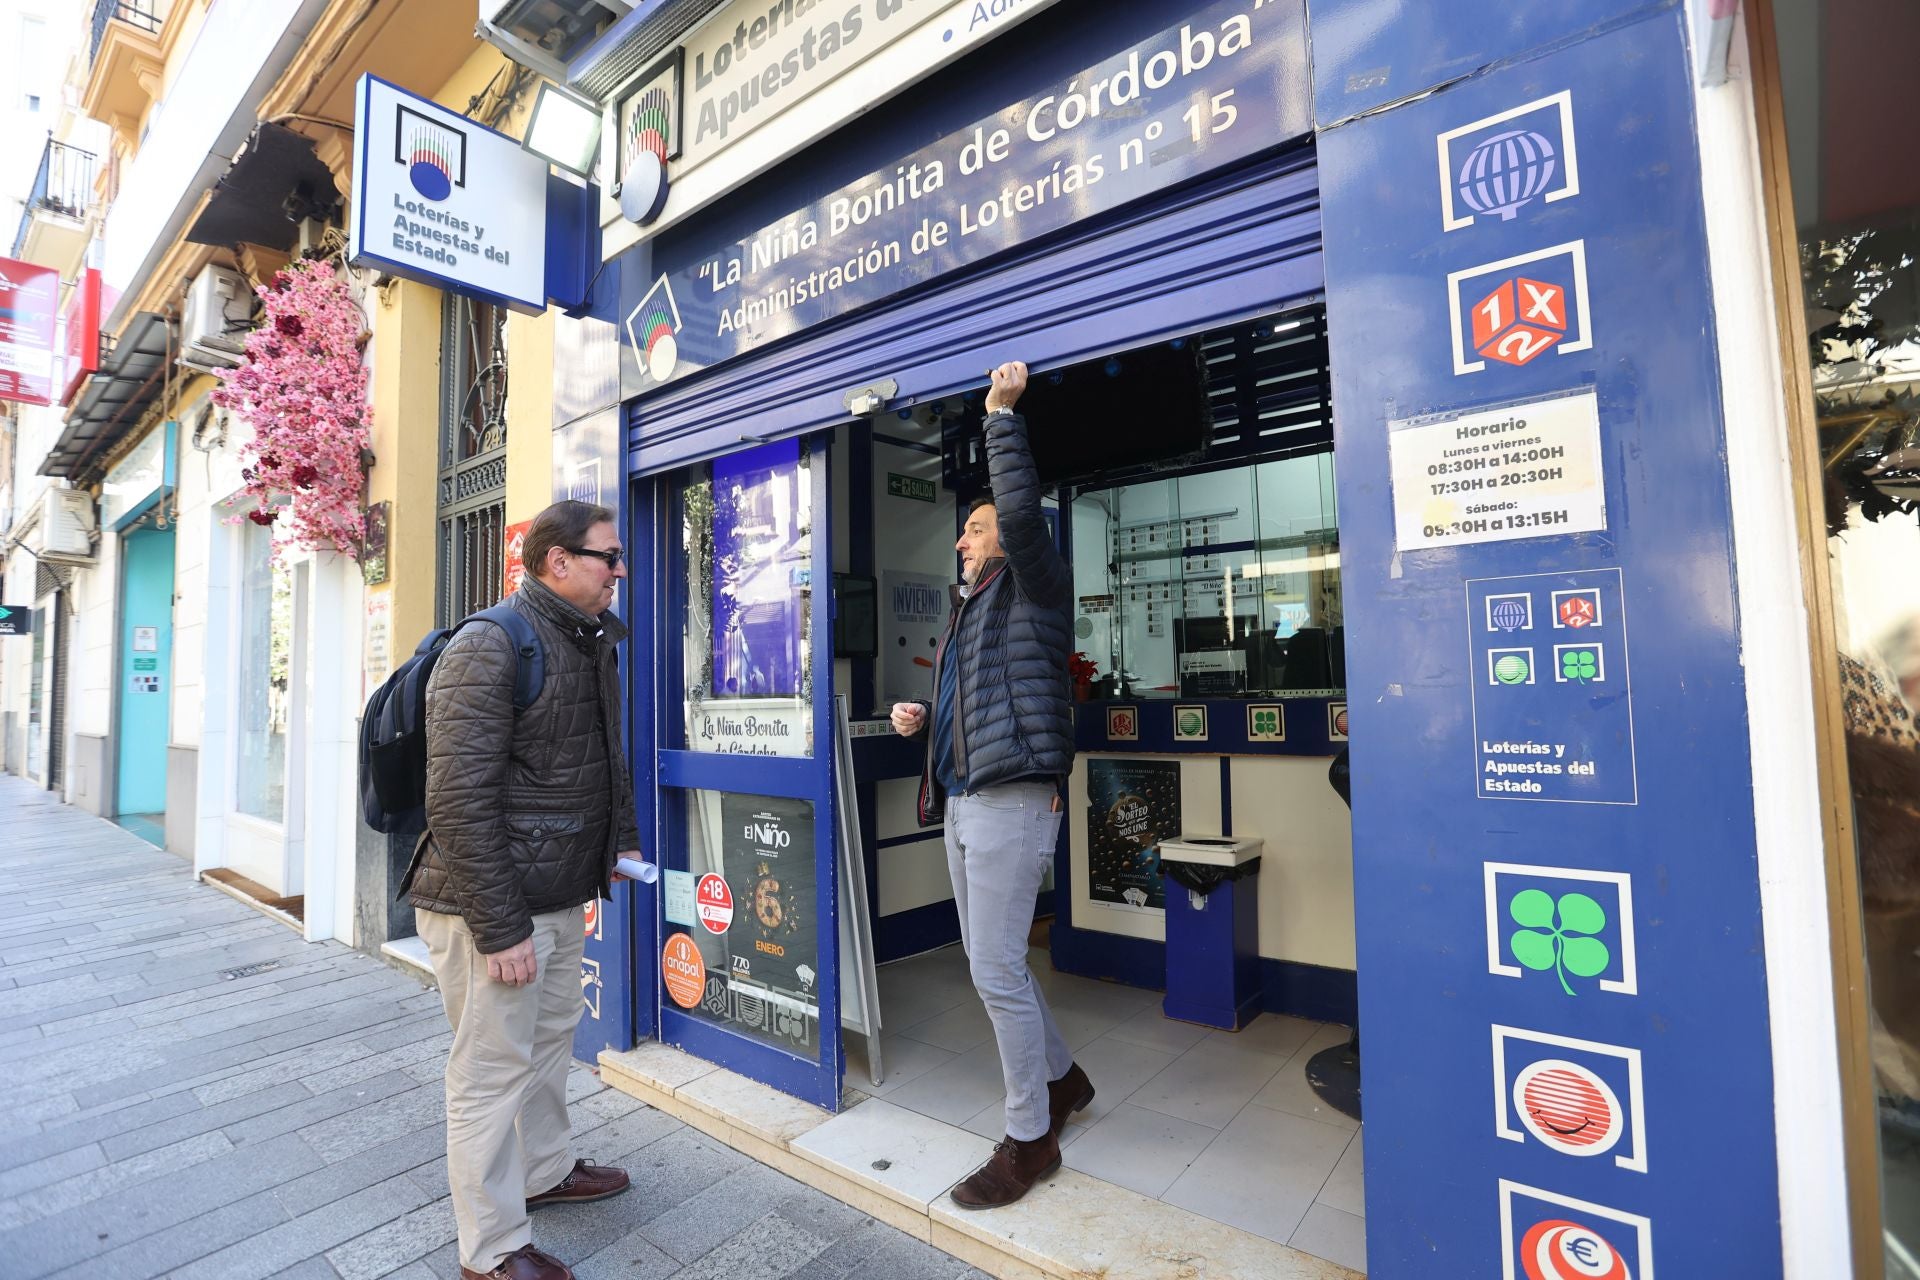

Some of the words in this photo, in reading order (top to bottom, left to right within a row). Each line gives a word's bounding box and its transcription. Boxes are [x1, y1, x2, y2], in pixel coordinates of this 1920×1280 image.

[695, 0, 822, 93] Loterí
[694, 4, 863, 146] Apuestas
[751, 220, 817, 274] Niña
[830, 159, 944, 238] Bonita
[958, 127, 1010, 176] de
[393, 193, 470, 232] Loterías
[474, 225, 484, 240] y
[717, 239, 900, 337] Administración
[911, 217, 948, 256] de
[960, 153, 1105, 237] Loterías
[1182, 88, 1238, 143] 15
[392, 232, 457, 266] Estado
[393, 214, 480, 255] Apuestas
[484, 245, 510, 265] del
[484, 430, 501, 449] 24
[1456, 417, 1527, 440] Horario
[1443, 446, 1480, 458] Lunes
[1481, 443, 1490, 452] a
[1491, 436, 1542, 450] viernes
[1427, 457, 1486, 476] 08:30H
[1489, 456, 1500, 467] a
[1502, 445, 1564, 465] 14:00H
[911, 482, 934, 499] SALIDA
[1431, 478, 1483, 496] 17:30H
[1486, 477, 1497, 488] a
[1500, 467, 1563, 486] 20:30H
[1465, 501, 1518, 515] Sábado:
[1490, 519, 1503, 530] a
[1506, 510, 1568, 528] 13:15H
[893, 585, 942, 616] INVIERNO
[701, 715, 715, 740] La
[717, 716, 743, 737] Niña
[744, 715, 789, 737] Bonita
[1482, 740, 1551, 755] Loterías
[1554, 743, 1565, 758] y
[1484, 759, 1562, 776] Apuestas
[1567, 760, 1595, 775] del
[1484, 778, 1542, 793] Estado
[1115, 805, 1148, 823] SORTEO
[754, 822, 791, 849] Niño
[1119, 826, 1132, 837] NOS
[1132, 820, 1148, 833] UNE
[703, 879, 724, 900] +18
[755, 878, 782, 928] 6
[755, 939, 785, 957] ENERO
[667, 956, 700, 977] anapal
